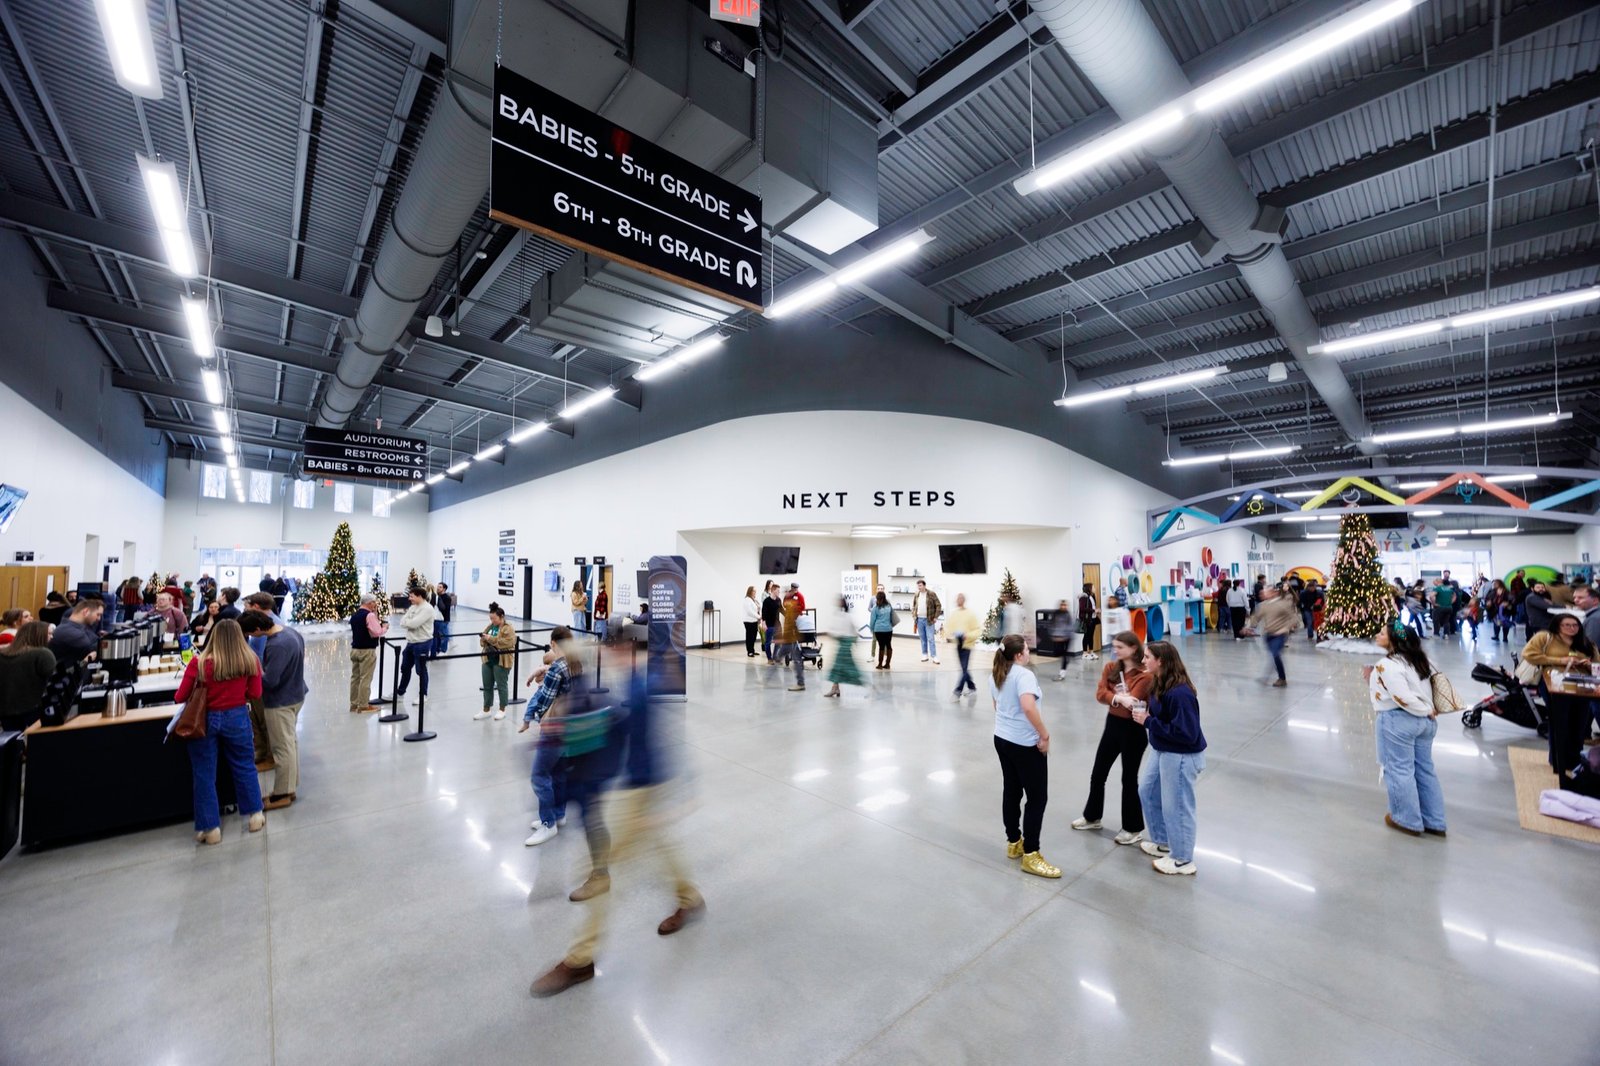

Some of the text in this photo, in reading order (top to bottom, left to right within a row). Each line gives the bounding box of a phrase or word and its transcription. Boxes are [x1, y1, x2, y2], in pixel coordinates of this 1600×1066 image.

[499, 94, 598, 158] BABIES
[620, 154, 654, 186] 5TH
[660, 174, 730, 220] GRADE
[553, 191, 594, 225] 6TH
[617, 217, 652, 247] 8TH
[658, 234, 731, 277] GRADE
[344, 433, 411, 448] AUDITORIUM
[345, 449, 410, 463] RESTROOMS
[307, 460, 348, 471] BABIES
[357, 465, 372, 474] 8TH
[373, 467, 409, 477] GRADE
[783, 491, 955, 509] NEXT STEPS
